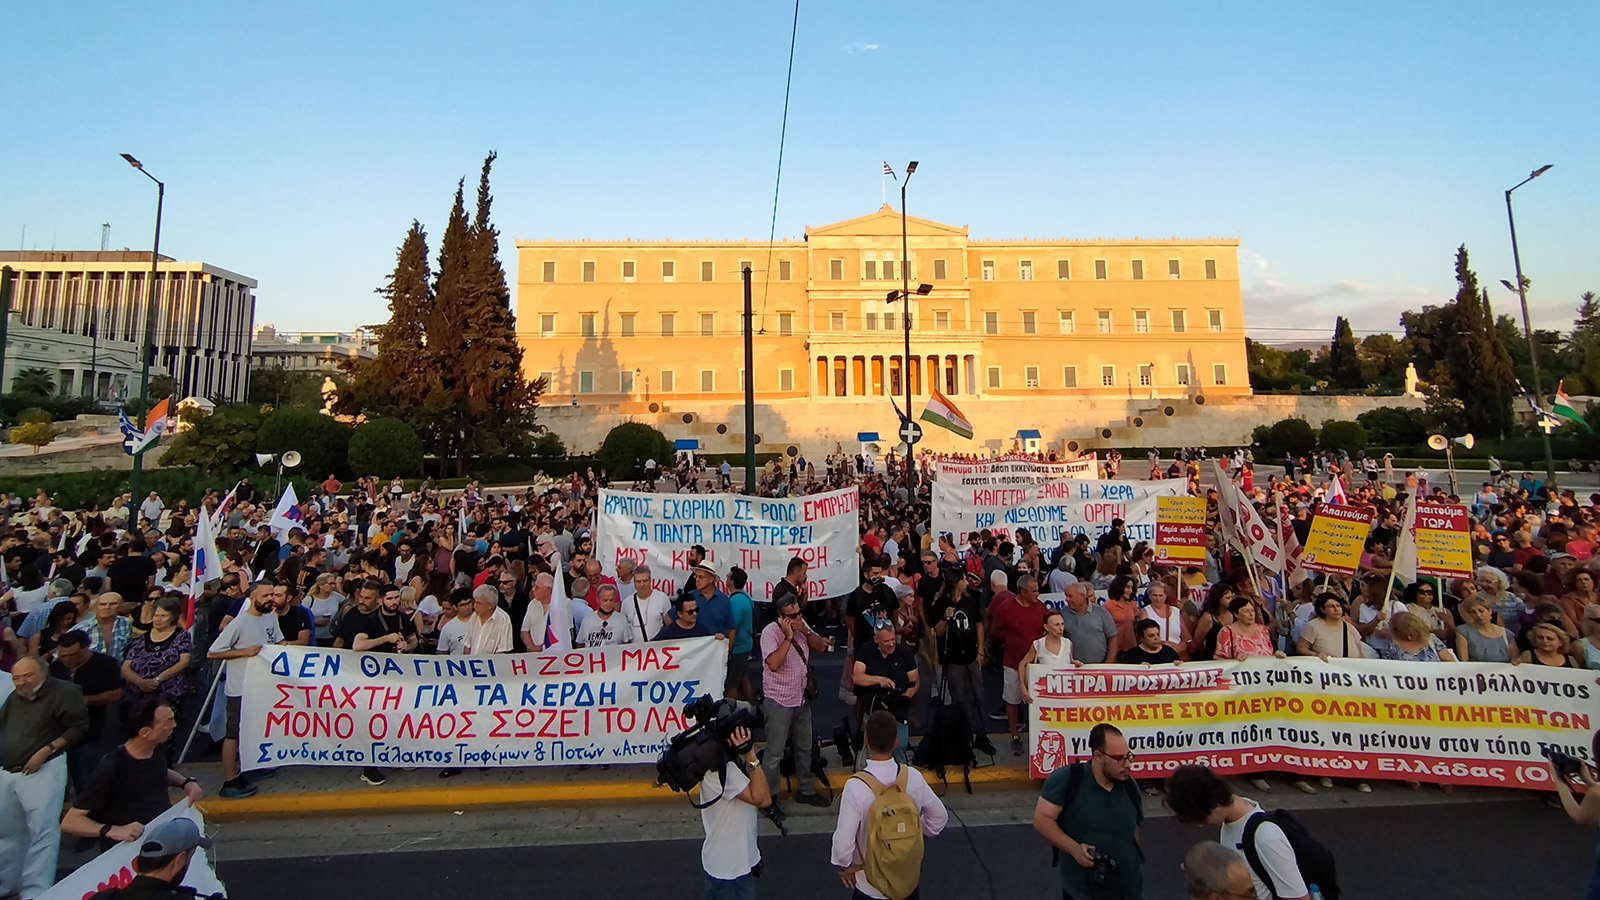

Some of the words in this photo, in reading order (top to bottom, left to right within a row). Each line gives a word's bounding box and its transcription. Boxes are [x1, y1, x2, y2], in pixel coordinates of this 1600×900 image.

[603, 494, 654, 519] ΚΡΑΤΟΣ
[662, 498, 726, 521] ΕΧΘΡΙΚΟ
[733, 499, 755, 521] ΣΕ
[973, 489, 1027, 506] ΚΑΙΓΕΤΑΙ
[1036, 482, 1070, 499] ΞΑΝΑ
[1080, 483, 1090, 499] Η
[1100, 484, 1135, 500] ΧΩΡΑ
[975, 512, 996, 529] ΚΑΙ
[1004, 505, 1068, 524] ΝΙΩΘΟΥΜΕ
[1084, 503, 1127, 523] ΟΡΓΗ!
[1416, 505, 1464, 518] παιτούμε
[1420, 517, 1454, 529] ΤΩΡΑ
[632, 520, 649, 541] ΤΑ
[654, 523, 703, 544] ΠΑΝΤΑ
[712, 523, 814, 547] ΚΑΤΑΣΤΡΕΦΕΙ
[615, 546, 649, 567] ΜΑΣ
[739, 548, 761, 570] ΤΗ
[787, 546, 828, 571] ΖΩΗ
[270, 651, 341, 678] ΔΕΝ
[360, 654, 404, 678] ΘΑ
[413, 659, 496, 678] ΓΙΝΕΙ
[511, 659, 528, 676] Η
[536, 652, 606, 676] ΖΩΗ
[621, 647, 681, 672] ΜΑΣ
[273, 684, 403, 710] ΣΤΑΧΤΗ
[414, 683, 459, 709] ΓΙΑ
[474, 683, 508, 707] ΤΑ
[520, 681, 617, 707] ΚΕΡΔΗ
[631, 680, 700, 705] ΤΟΥΣ
[1046, 674, 1107, 695] ΜΕΤΡΑ
[1111, 670, 1220, 692] ΠΡΟΣΤΑΣΙΑΣ
[1231, 670, 1261, 687] της
[1266, 667, 1313, 687] ζωής
[1320, 671, 1353, 690] μας
[1357, 672, 1388, 689] και
[1393, 674, 1429, 691] του
[1436, 673, 1591, 700] περιβάλλοντος
[264, 710, 355, 740] ΜΟΝΟ
[368, 713, 388, 741] Ο
[397, 710, 477, 741] ΛΑΟΣ
[489, 708, 590, 738] ΣΩΖΕΙ
[598, 707, 636, 735] ΤΟ
[1039, 702, 1174, 723] ΣΤΕΚΟΜΑΣΤΕ
[1178, 701, 1219, 719] ΣΤΟ
[1224, 697, 1304, 716] ΠΛΕΥΡΟ
[1311, 698, 1377, 719] ΟΛΩΝ
[1383, 702, 1432, 721] ΤΩΝ
[1439, 705, 1591, 731] ΠΛΗΓΕΝΤΩΝ
[257, 742, 365, 764] Συνδικάτο
[371, 742, 454, 765] Γάλακτος
[454, 743, 530, 766] Τροφίμων
[551, 741, 605, 761] Ποτών
[1071, 737, 1091, 754] γι
[1128, 730, 1193, 751] σταθούν
[1198, 728, 1224, 746] στα
[1231, 724, 1273, 746] πόδια
[1278, 727, 1325, 747] τους,
[1332, 731, 1353, 746] να
[1359, 730, 1431, 751] μείνουν
[1439, 737, 1480, 753] στον
[1485, 736, 1532, 756] τόπο
[1129, 754, 1234, 772] σπονδία
[1241, 753, 1370, 770] Γυναικών
[1378, 757, 1506, 781] Ελλάδας
